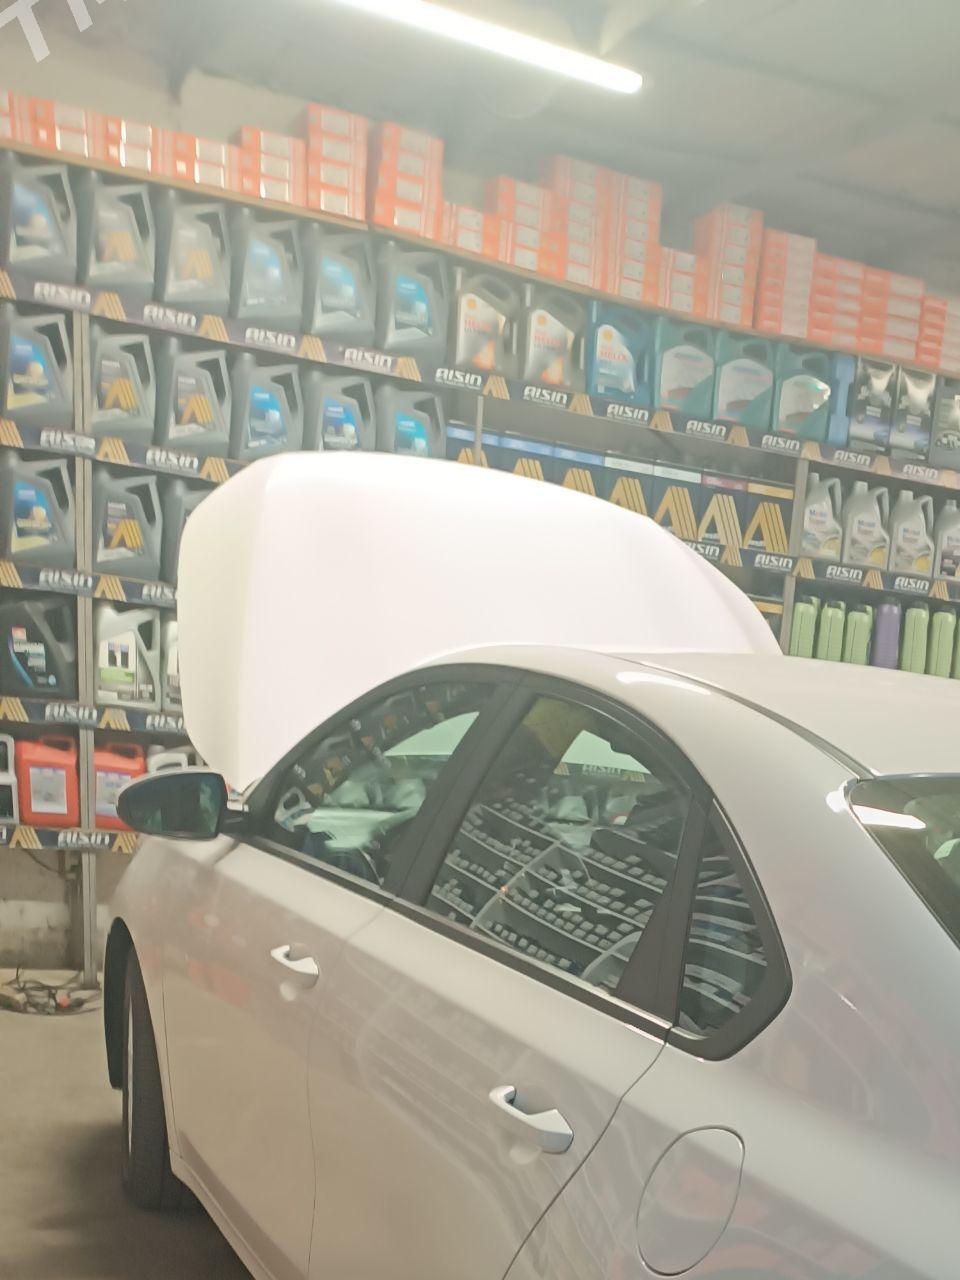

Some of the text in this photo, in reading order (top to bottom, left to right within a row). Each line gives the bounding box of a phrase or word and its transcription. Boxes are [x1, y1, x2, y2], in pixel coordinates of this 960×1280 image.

[245, 328, 296, 348] AISIN
[344, 348, 392, 369] AISIN
[436, 367, 482, 387] AISIN
[524, 386, 568, 404] AISIN
[607, 404, 649, 421] AISIN
[686, 420, 726, 436] AISIN
[762, 434, 800, 450] AISIN
[146, 448, 199, 468] AISIN
[834, 450, 871, 465] AISIN
[903, 464, 938, 479] AISIN
[755, 553, 792, 569] AISIN
[826, 565, 863, 579] AISIN
[142, 584, 177, 600] AIS
[895, 577, 930, 591] AISIN
